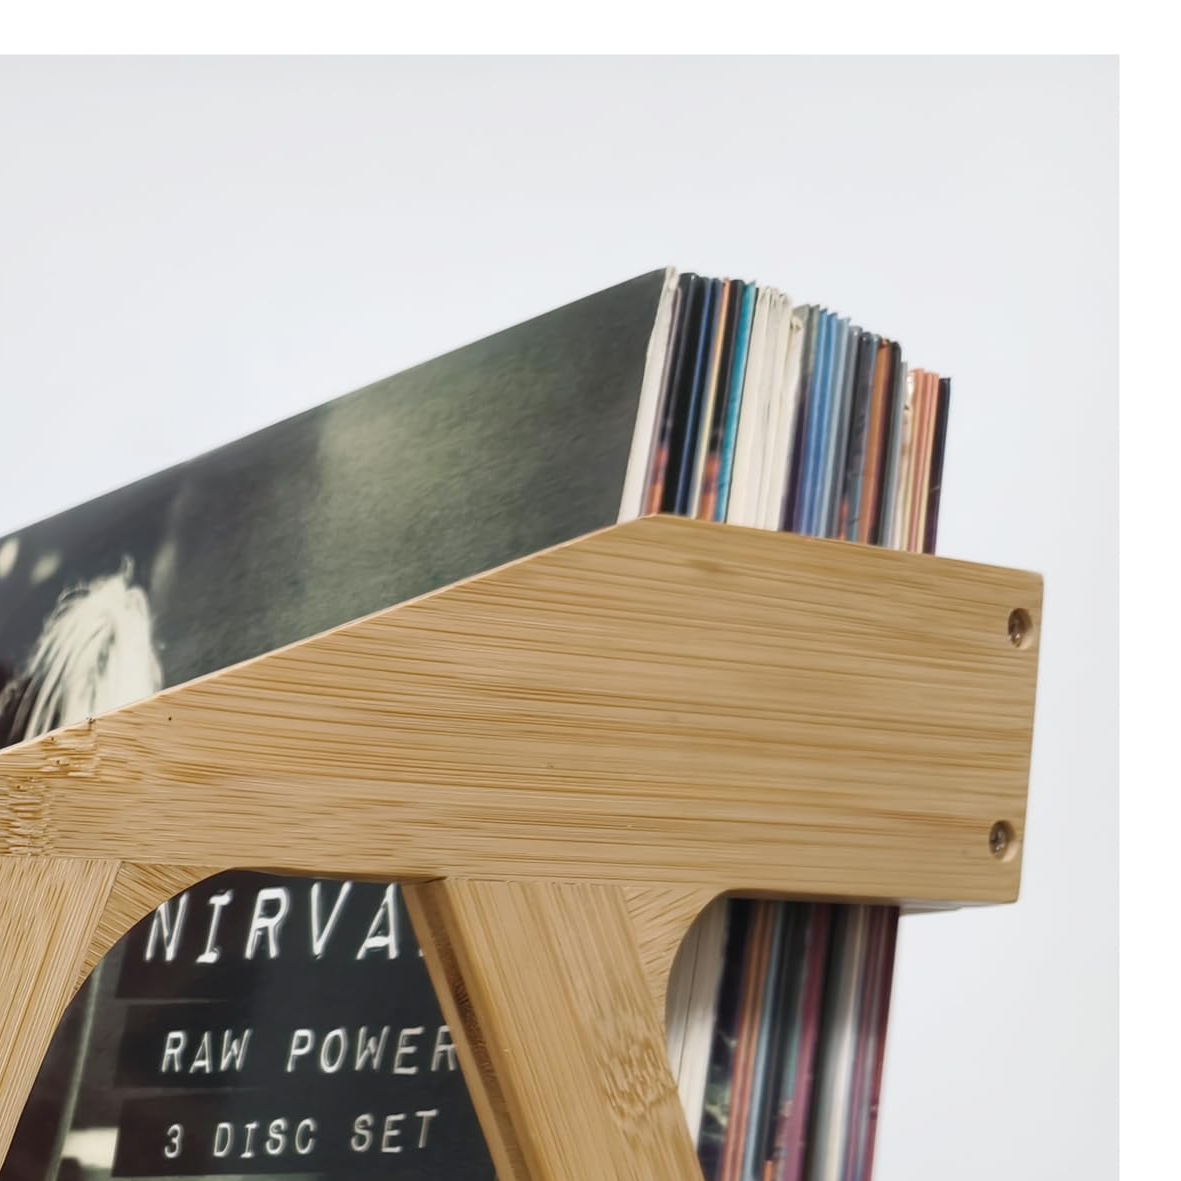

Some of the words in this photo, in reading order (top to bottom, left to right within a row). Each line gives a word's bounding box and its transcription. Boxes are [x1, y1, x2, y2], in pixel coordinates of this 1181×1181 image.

[143, 880, 425, 964] NIRVA
[160, 1028, 253, 1074] RAW
[286, 1025, 458, 1075] POWER
[163, 1124, 184, 1158] 3
[213, 1117, 319, 1159] DISC
[349, 1109, 439, 1153] SET
